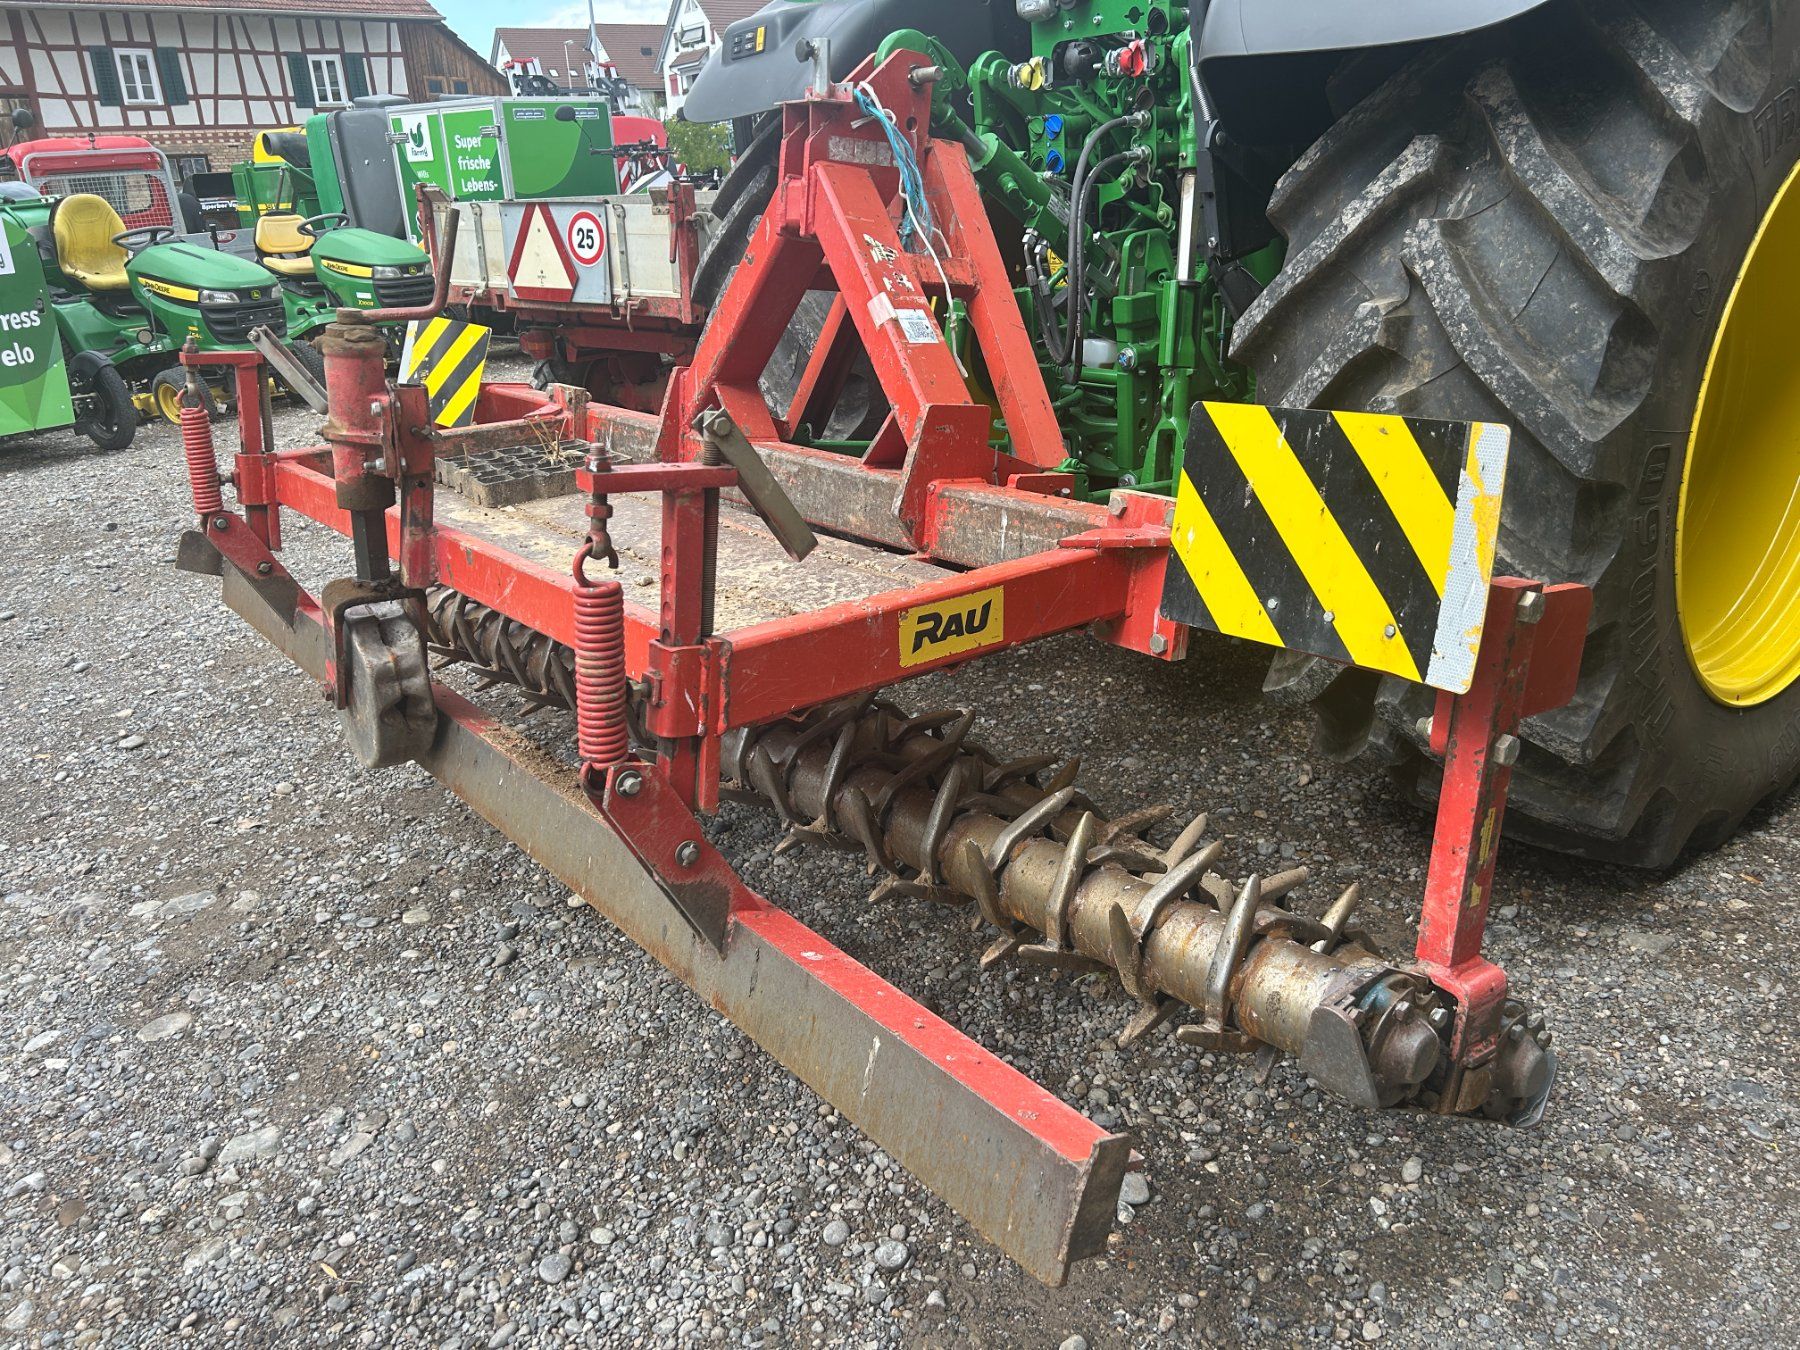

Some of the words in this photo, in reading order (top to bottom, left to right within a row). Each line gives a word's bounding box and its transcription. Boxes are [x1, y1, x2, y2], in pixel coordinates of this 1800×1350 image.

[454, 134, 481, 152] Super
[457, 155, 491, 171] frische
[461, 177, 498, 192] Lebens-
[577, 227, 595, 250] 25
[912, 599, 993, 655] RAU
